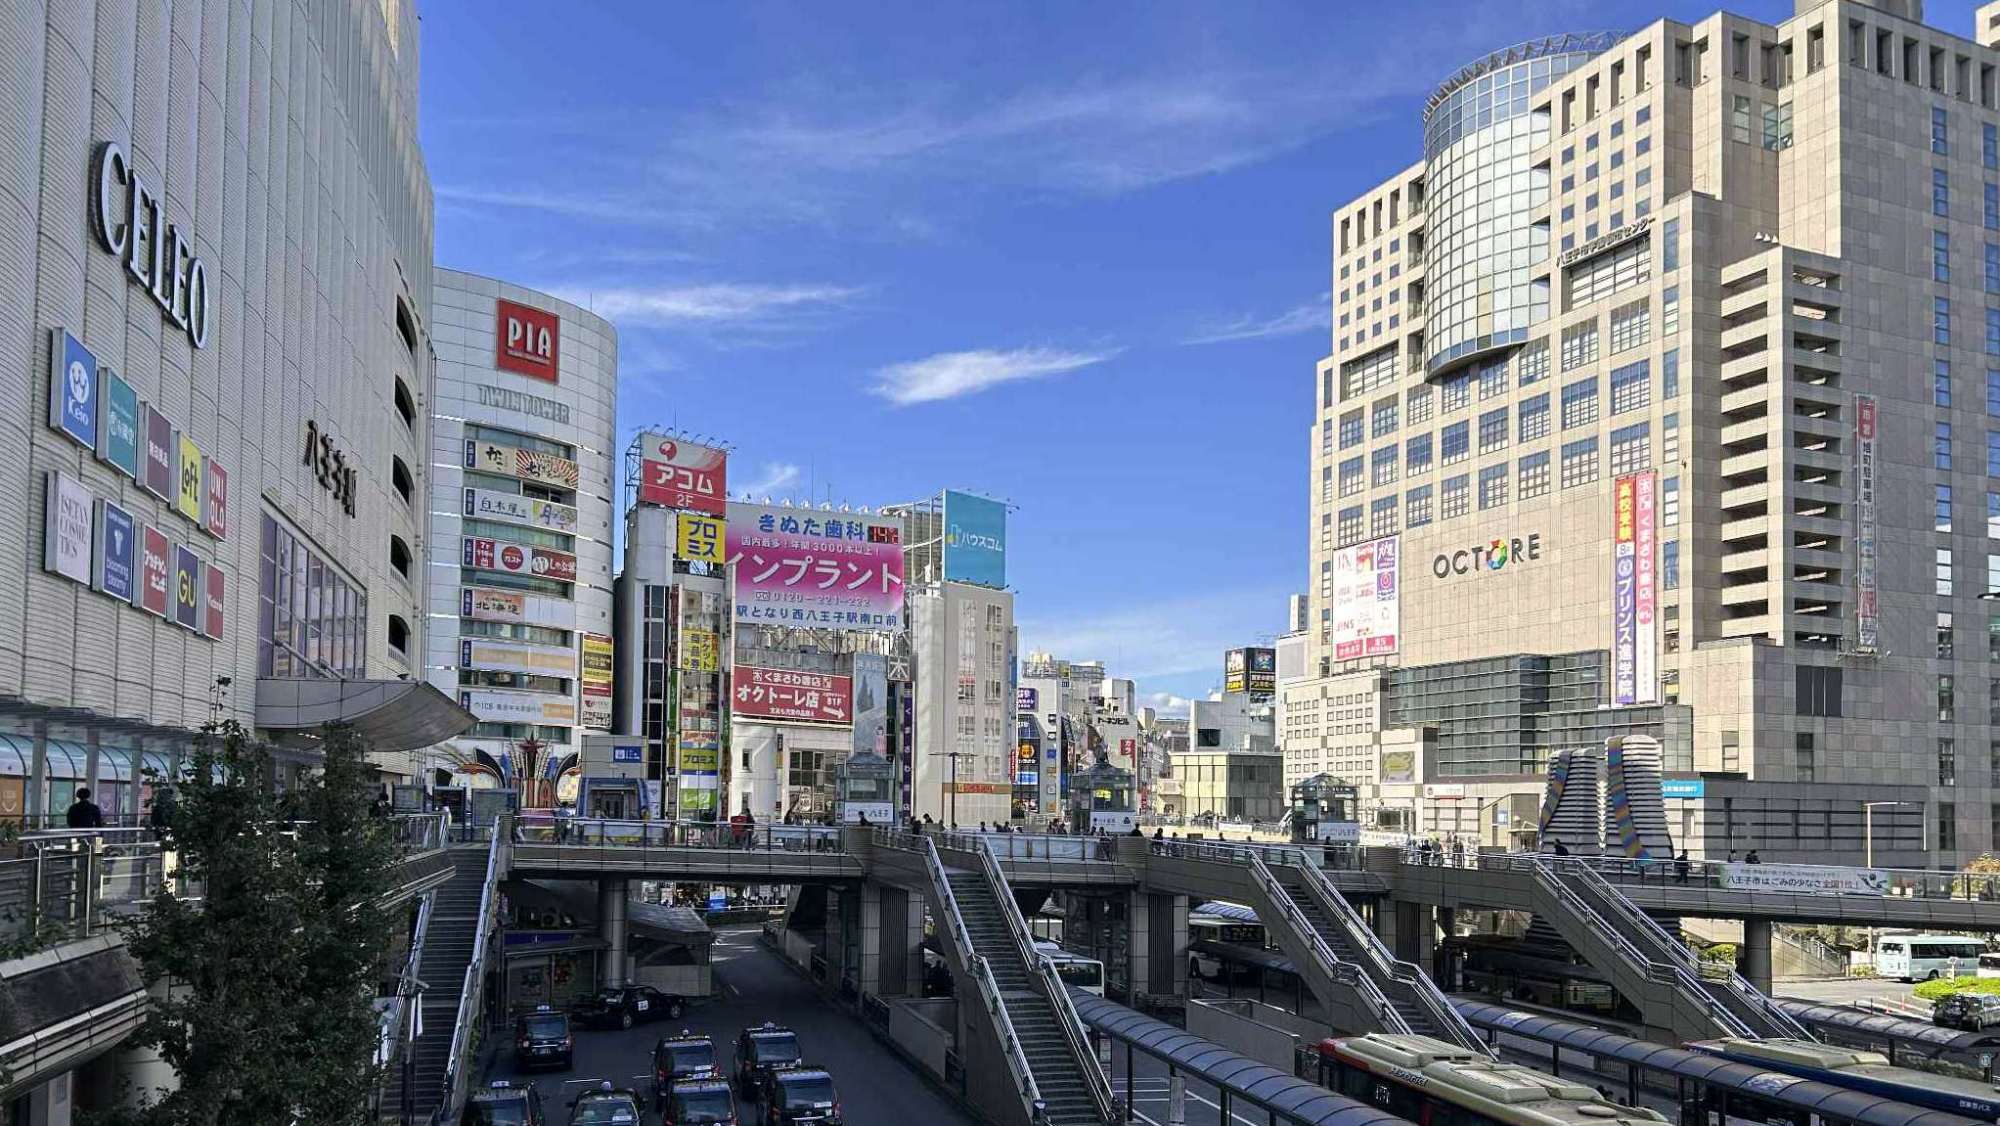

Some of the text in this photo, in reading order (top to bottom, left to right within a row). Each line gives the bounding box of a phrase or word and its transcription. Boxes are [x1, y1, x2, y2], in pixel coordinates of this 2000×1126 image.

[97, 141, 208, 348] CELEO
[507, 316, 552, 359] PIA
[68, 396, 88, 425] Keio
[479, 386, 570, 425] TWIN TOWER
[210, 470, 225, 501] UNI
[656, 463, 714, 495] アコム
[676, 493, 695, 508] 2F
[209, 501, 225, 530] QLO
[687, 520, 717, 540] プロ
[758, 513, 866, 541] きぬた歯科
[687, 539, 717, 558] ミス
[960, 532, 1004, 552] ハウスコム
[1432, 533, 1541, 579] OCTORE
[725, 552, 902, 594] インプラント
[178, 569, 197, 608] GU
[736, 604, 898, 627] 駅となり西八王子駅南口前
[764, 671, 821, 688] くまさわ書店
[737, 684, 820, 708] オクトーレ店
